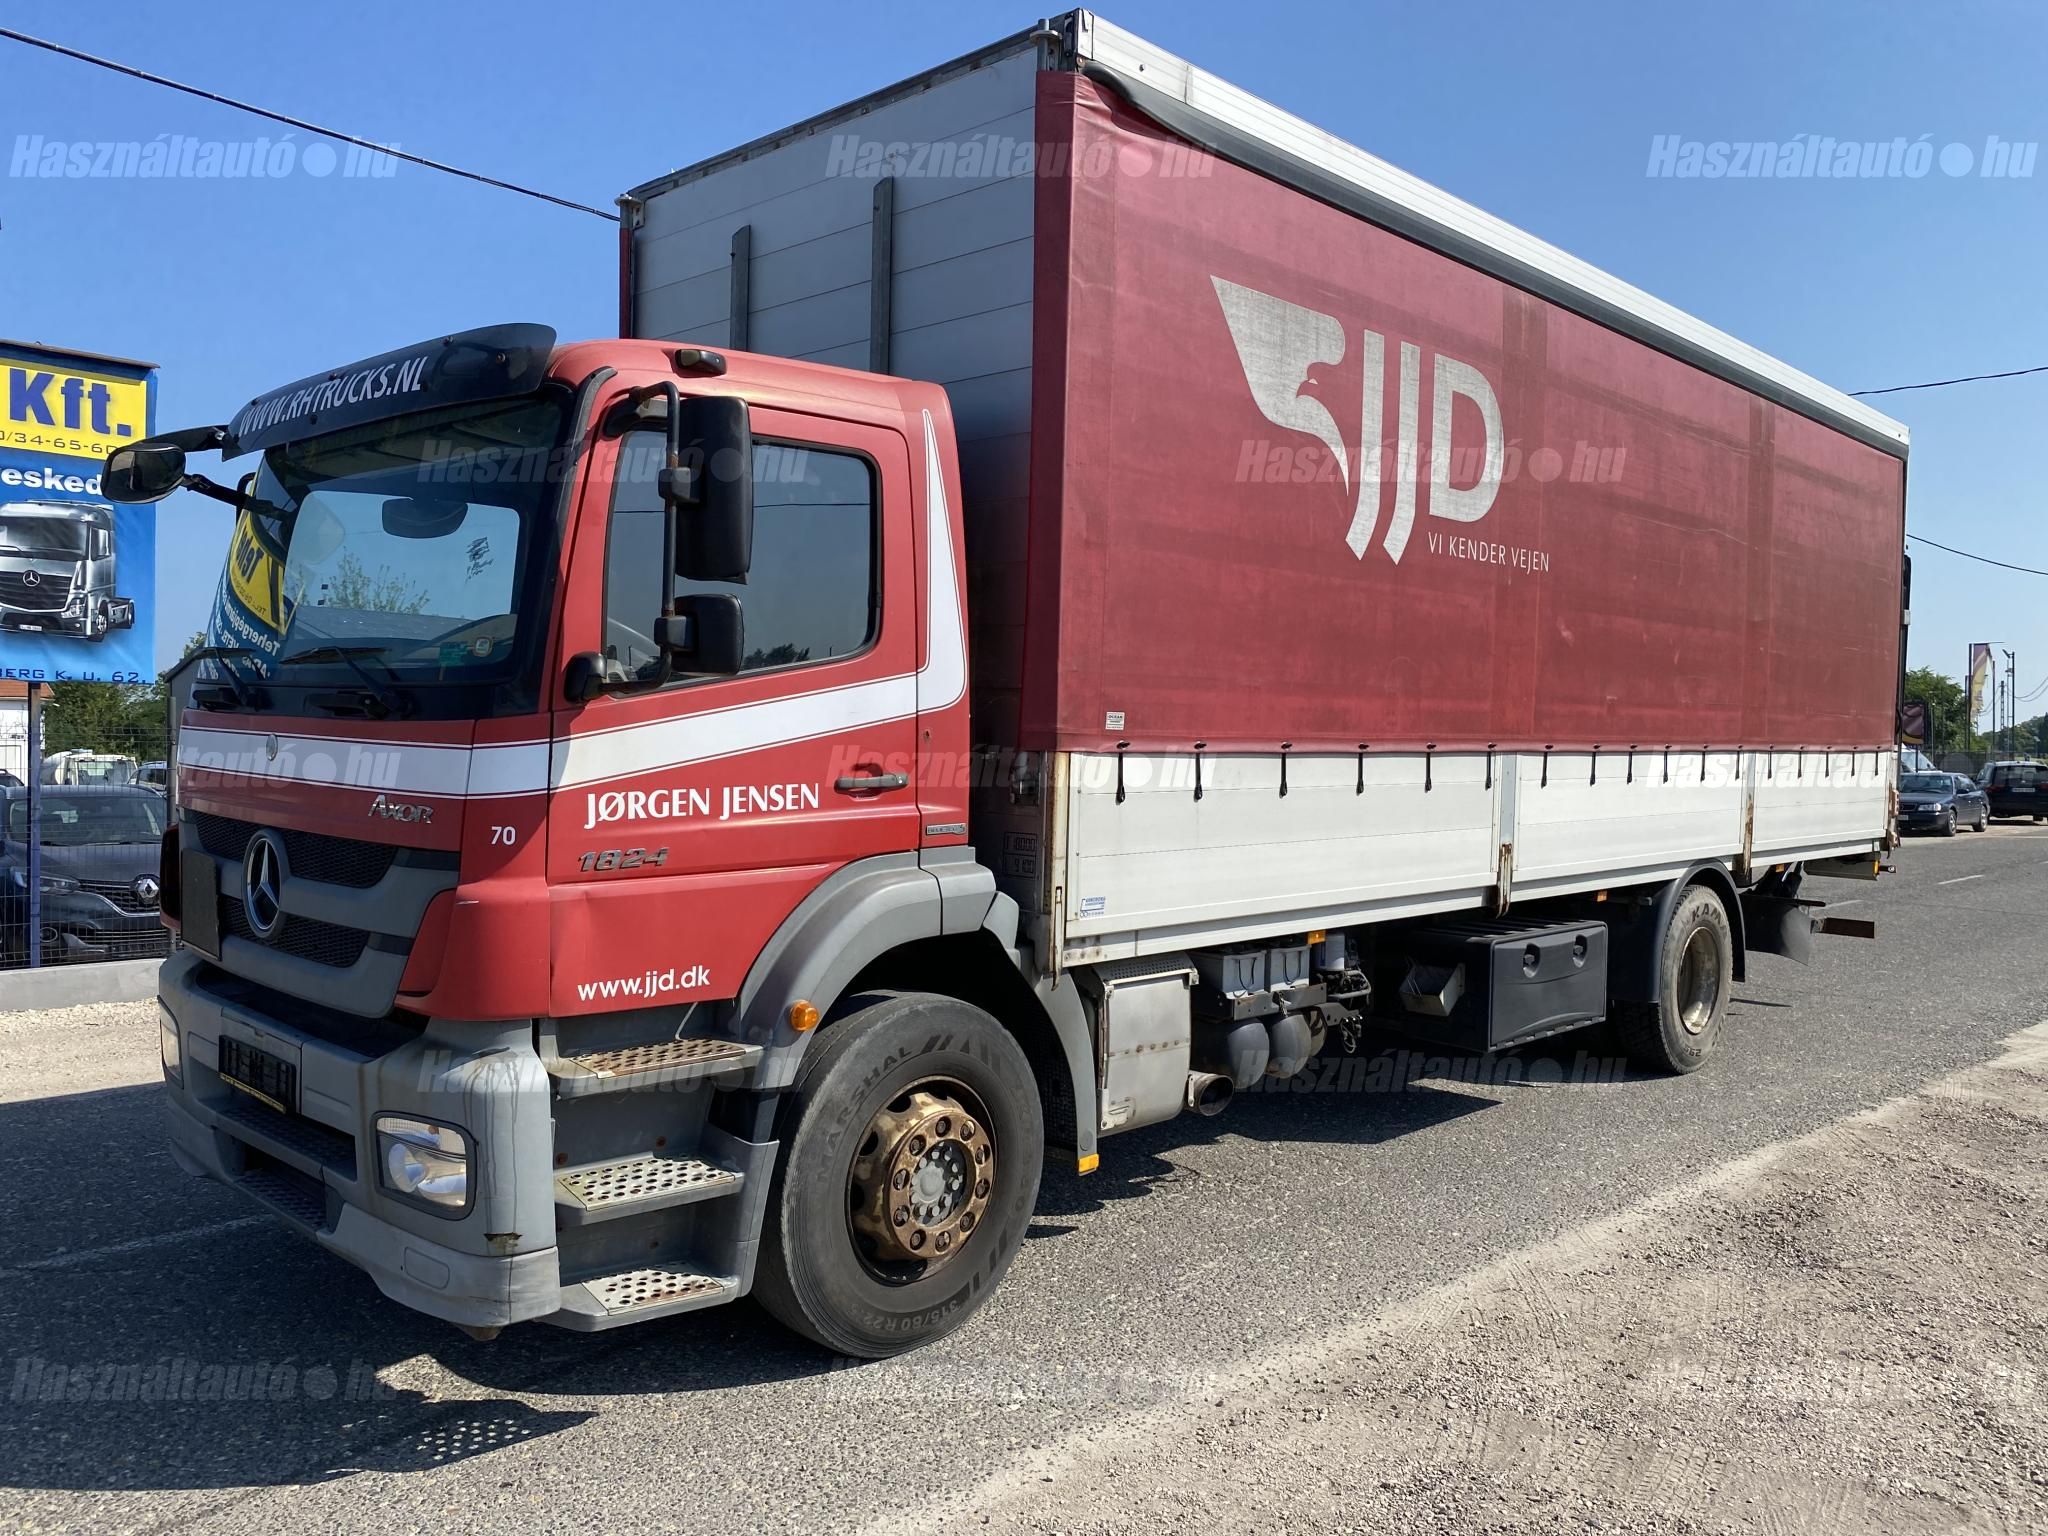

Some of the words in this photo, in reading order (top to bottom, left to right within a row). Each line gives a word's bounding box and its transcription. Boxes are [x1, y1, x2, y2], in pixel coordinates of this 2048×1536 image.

[9, 367, 132, 437] Kft.
[239, 356, 429, 438] WWW.RHTRUCKS.NL
[0, 467, 103, 496] esked
[1427, 531, 1443, 554] VI
[1449, 535, 1506, 565] KENDER
[1510, 547, 1550, 575] VEJEN
[0, 668, 45, 679] ERG
[584, 787, 710, 829] JØRGEN
[719, 782, 819, 820] JENSEN
[490, 826, 516, 845] 70
[577, 847, 669, 872] 1824
[577, 965, 711, 1001] www.jjd.dk
